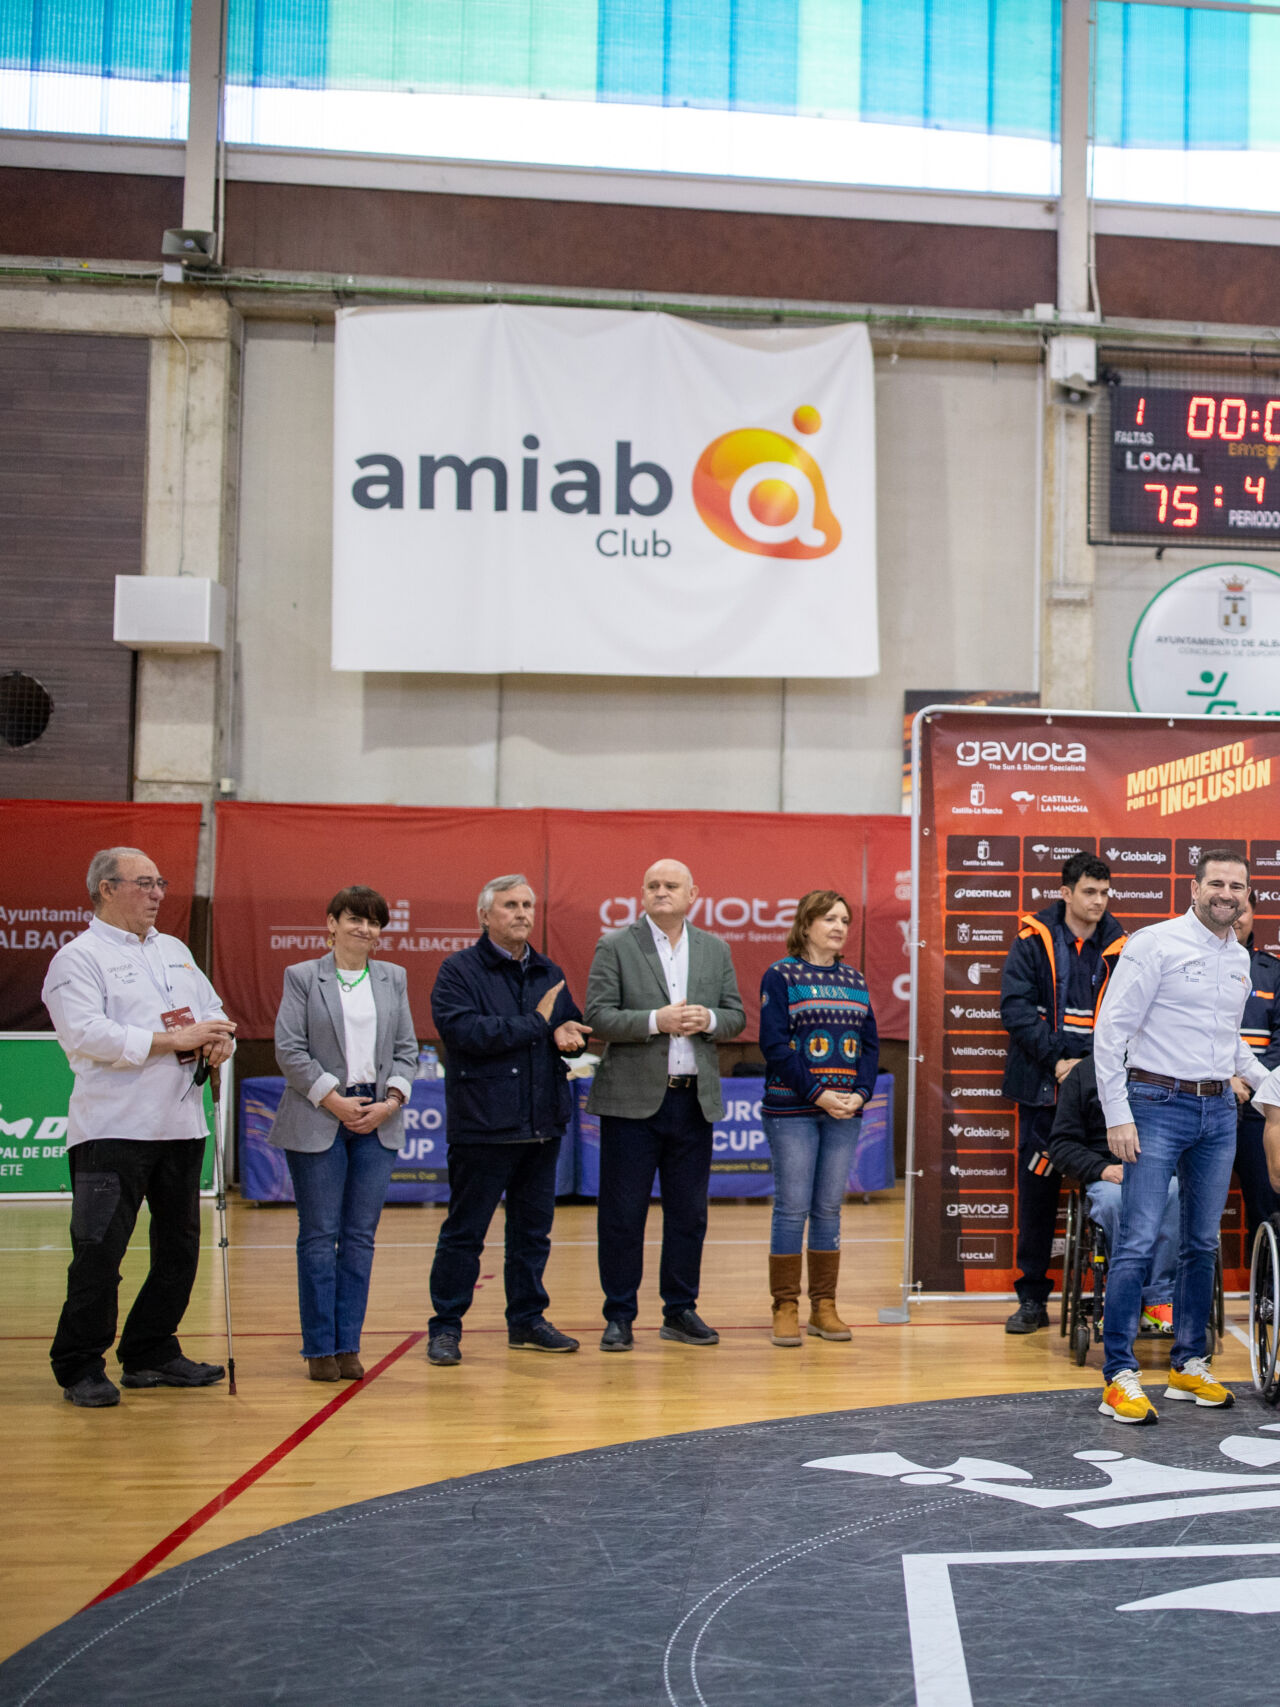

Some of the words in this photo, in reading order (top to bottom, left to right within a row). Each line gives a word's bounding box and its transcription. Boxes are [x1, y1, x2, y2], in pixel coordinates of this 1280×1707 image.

[1135, 397, 1146, 426] 1
[1113, 430, 1155, 447] FALTAS
[1125, 450, 1201, 474] LOCAL
[350, 433, 674, 517] amiab
[1143, 483, 1199, 528] 75
[1243, 475, 1266, 505] 4
[595, 528, 673, 559] Club
[1155, 635, 1240, 648] AYUNTAMIENTO
[1241, 639, 1256, 648] DE
[956, 741, 1087, 767] gaviota
[1002, 763, 1016, 771] Sun
[1016, 763, 1022, 771] &
[1023, 763, 1048, 771] Shutter
[1126, 741, 1245, 797] MOVIMIENTO
[1160, 757, 1271, 817] INCLUSIÓN
[1041, 804, 1052, 813] LA
[1052, 805, 1089, 814] MANCHA
[1126, 795, 1145, 812] POR
[1146, 792, 1159, 806] LA
[1120, 851, 1167, 865] Globalcaja
[965, 889, 1012, 899] DECATHLON
[0, 906, 93, 925] Ayuntamie
[0, 931, 77, 949] ALBAC
[270, 935, 328, 950] DIPUTA
[962, 1088, 1002, 1096] DECATHLO
[712, 1130, 765, 1151] CUP
[963, 1126, 1010, 1140] Globalcaja
[22, 1146, 40, 1159] DE
[397, 1138, 435, 1160] UP
[946, 1203, 1009, 1217] gaviota
[965, 1252, 994, 1260] UCLM
